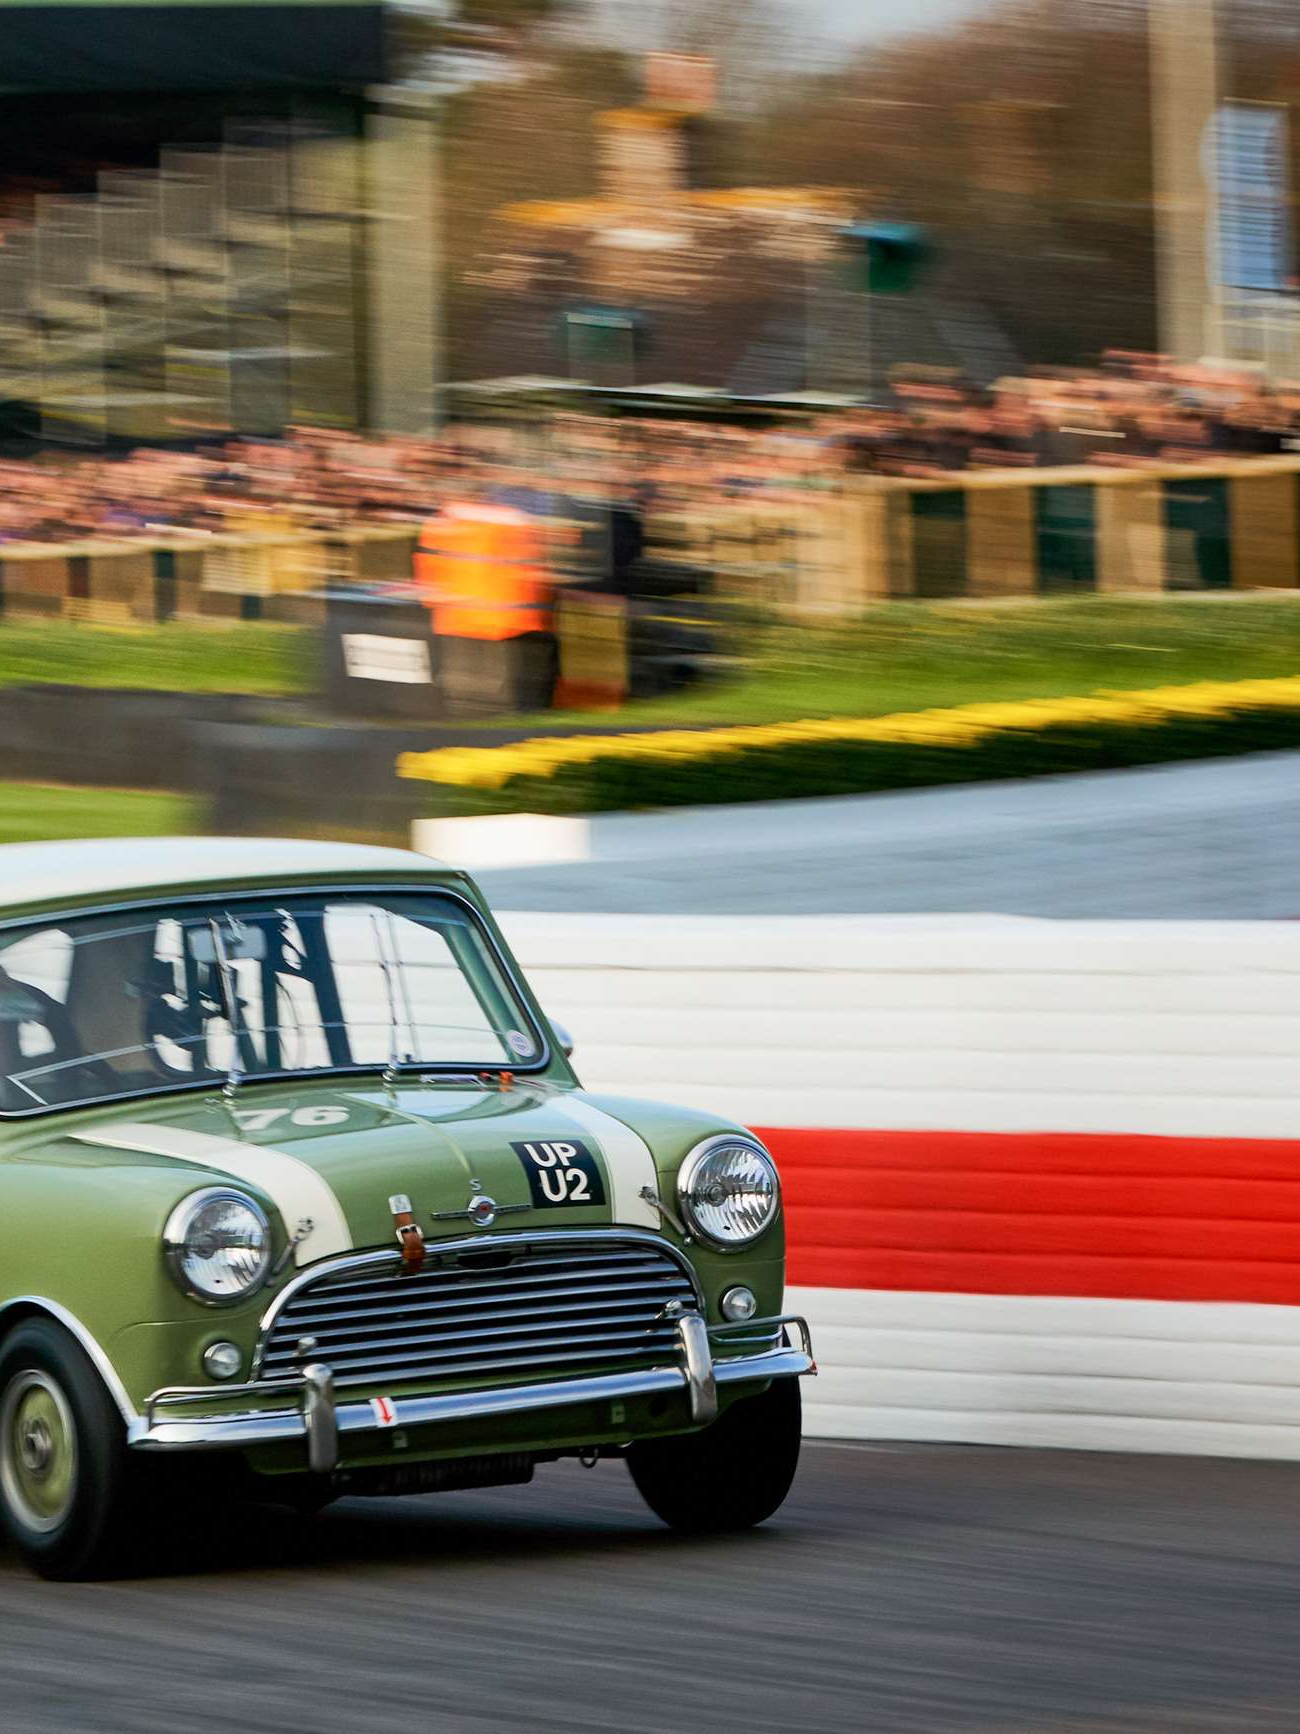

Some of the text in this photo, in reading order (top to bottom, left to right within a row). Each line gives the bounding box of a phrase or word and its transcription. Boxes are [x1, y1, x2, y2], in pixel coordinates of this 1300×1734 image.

[232, 1105, 350, 1131] 76
[524, 1142, 577, 1168] UP
[539, 1168, 591, 1202] U2
